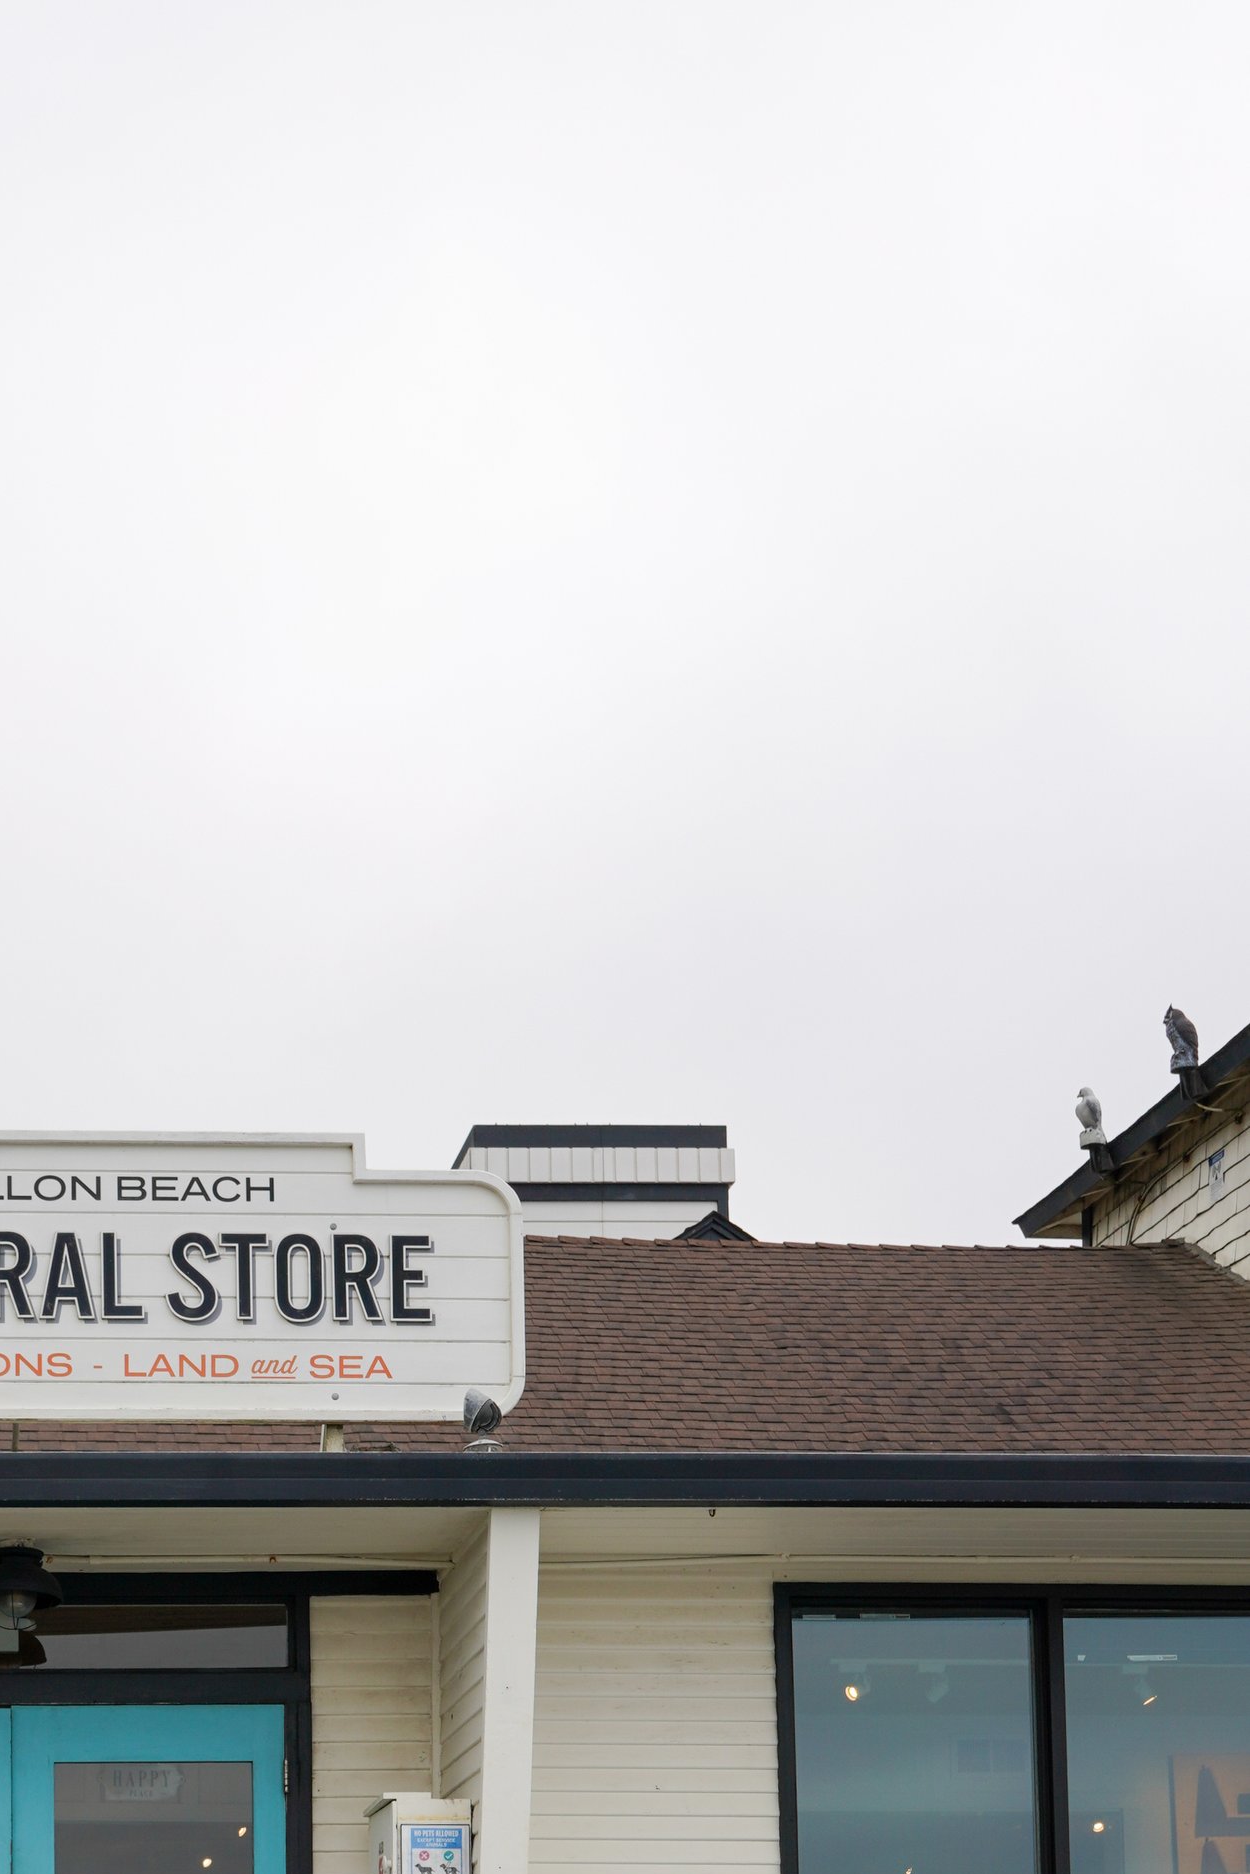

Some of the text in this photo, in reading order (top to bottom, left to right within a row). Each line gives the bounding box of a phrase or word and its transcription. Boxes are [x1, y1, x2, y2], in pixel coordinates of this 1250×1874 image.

[117, 1175, 276, 1204] BEACH
[167, 1230, 435, 1327] STORE
[122, 1353, 241, 1379] LAND
[251, 1354, 297, 1379] and
[308, 1354, 394, 1380] SEA
[112, 1769, 170, 1788] HAPPY
